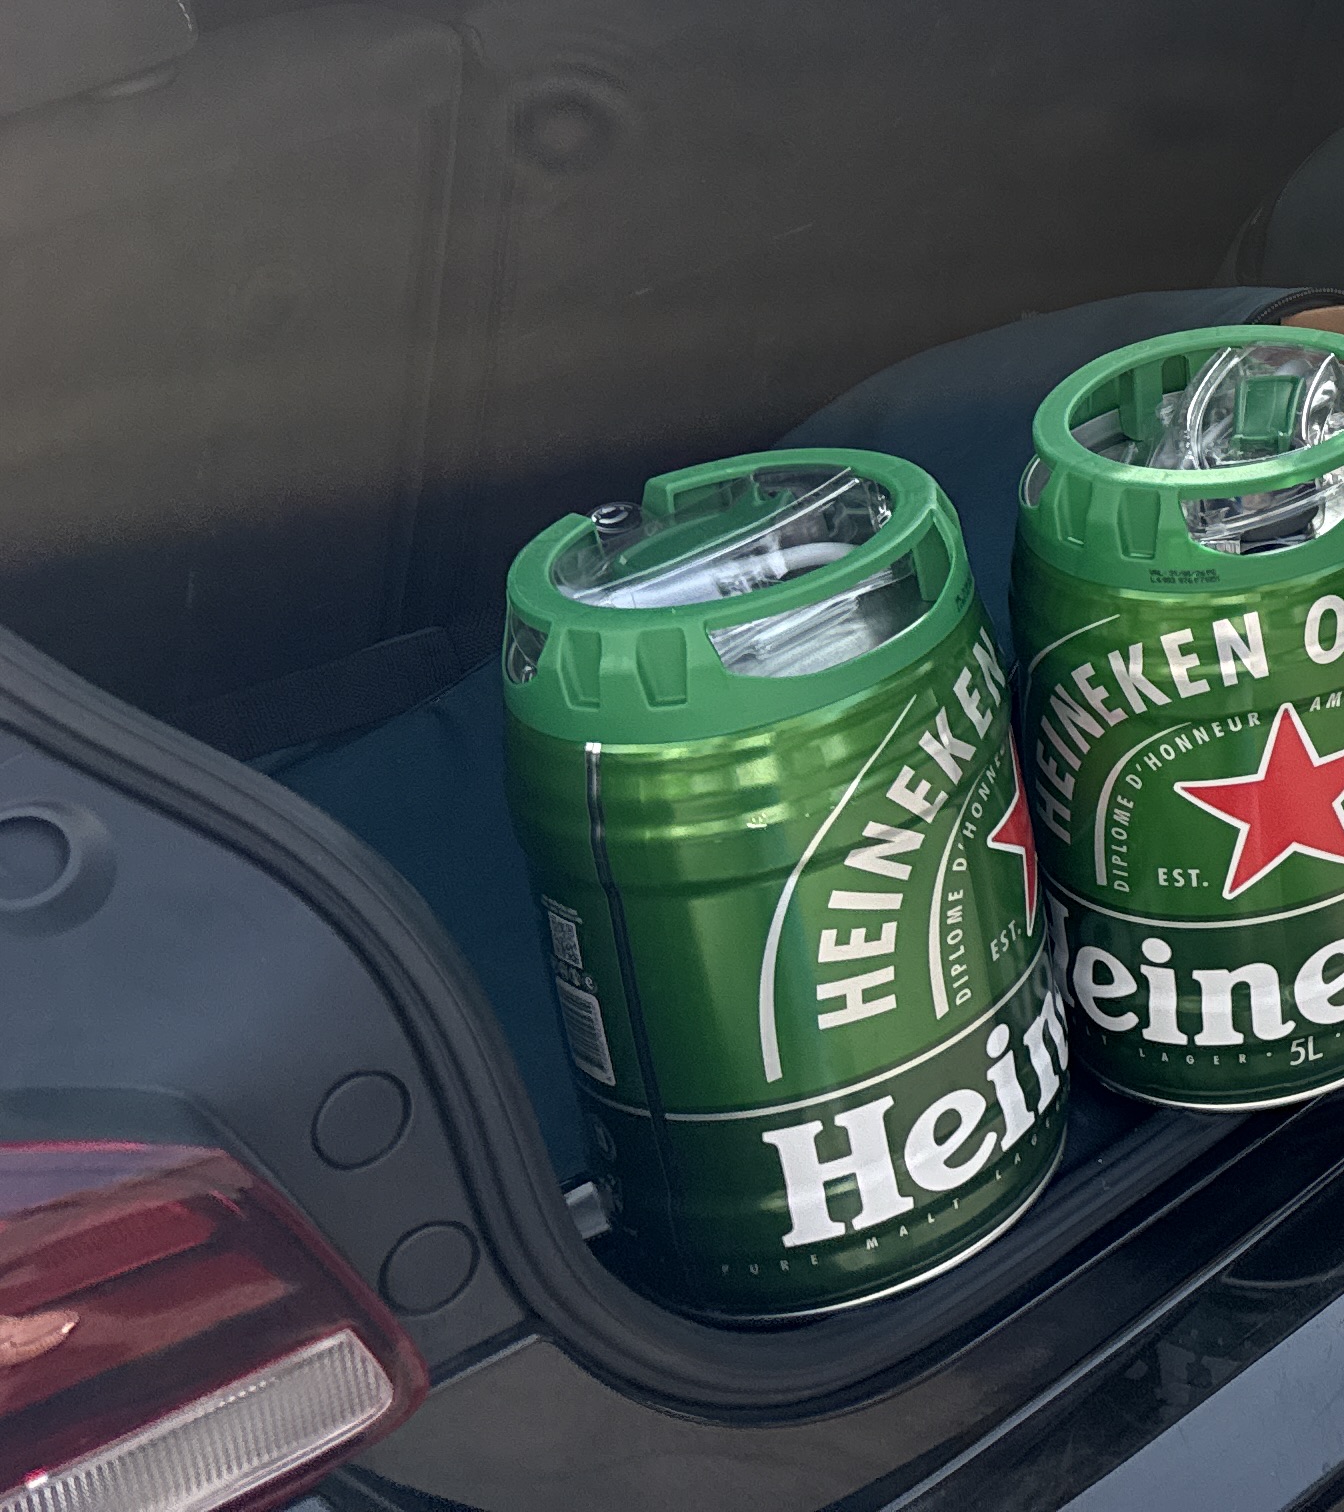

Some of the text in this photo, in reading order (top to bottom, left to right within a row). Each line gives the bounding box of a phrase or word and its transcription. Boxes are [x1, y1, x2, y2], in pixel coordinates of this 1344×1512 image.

[1035, 610, 1270, 845] HEINEKEN
[816, 626, 1006, 1030] HEINEKEN
[1110, 794, 1135, 893] DIPLOME
[1125, 711, 1262, 791] D'HONNEUR
[1157, 867, 1210, 888] EST.
[946, 888, 972, 1007] DIPLOME
[989, 918, 1023, 963] EST.
[1138, 1047, 1248, 1066] LAGER
[1289, 1035, 1324, 1066] 5L
[761, 990, 1069, 1248] Hein
[865, 1197, 961, 1251] MALT
